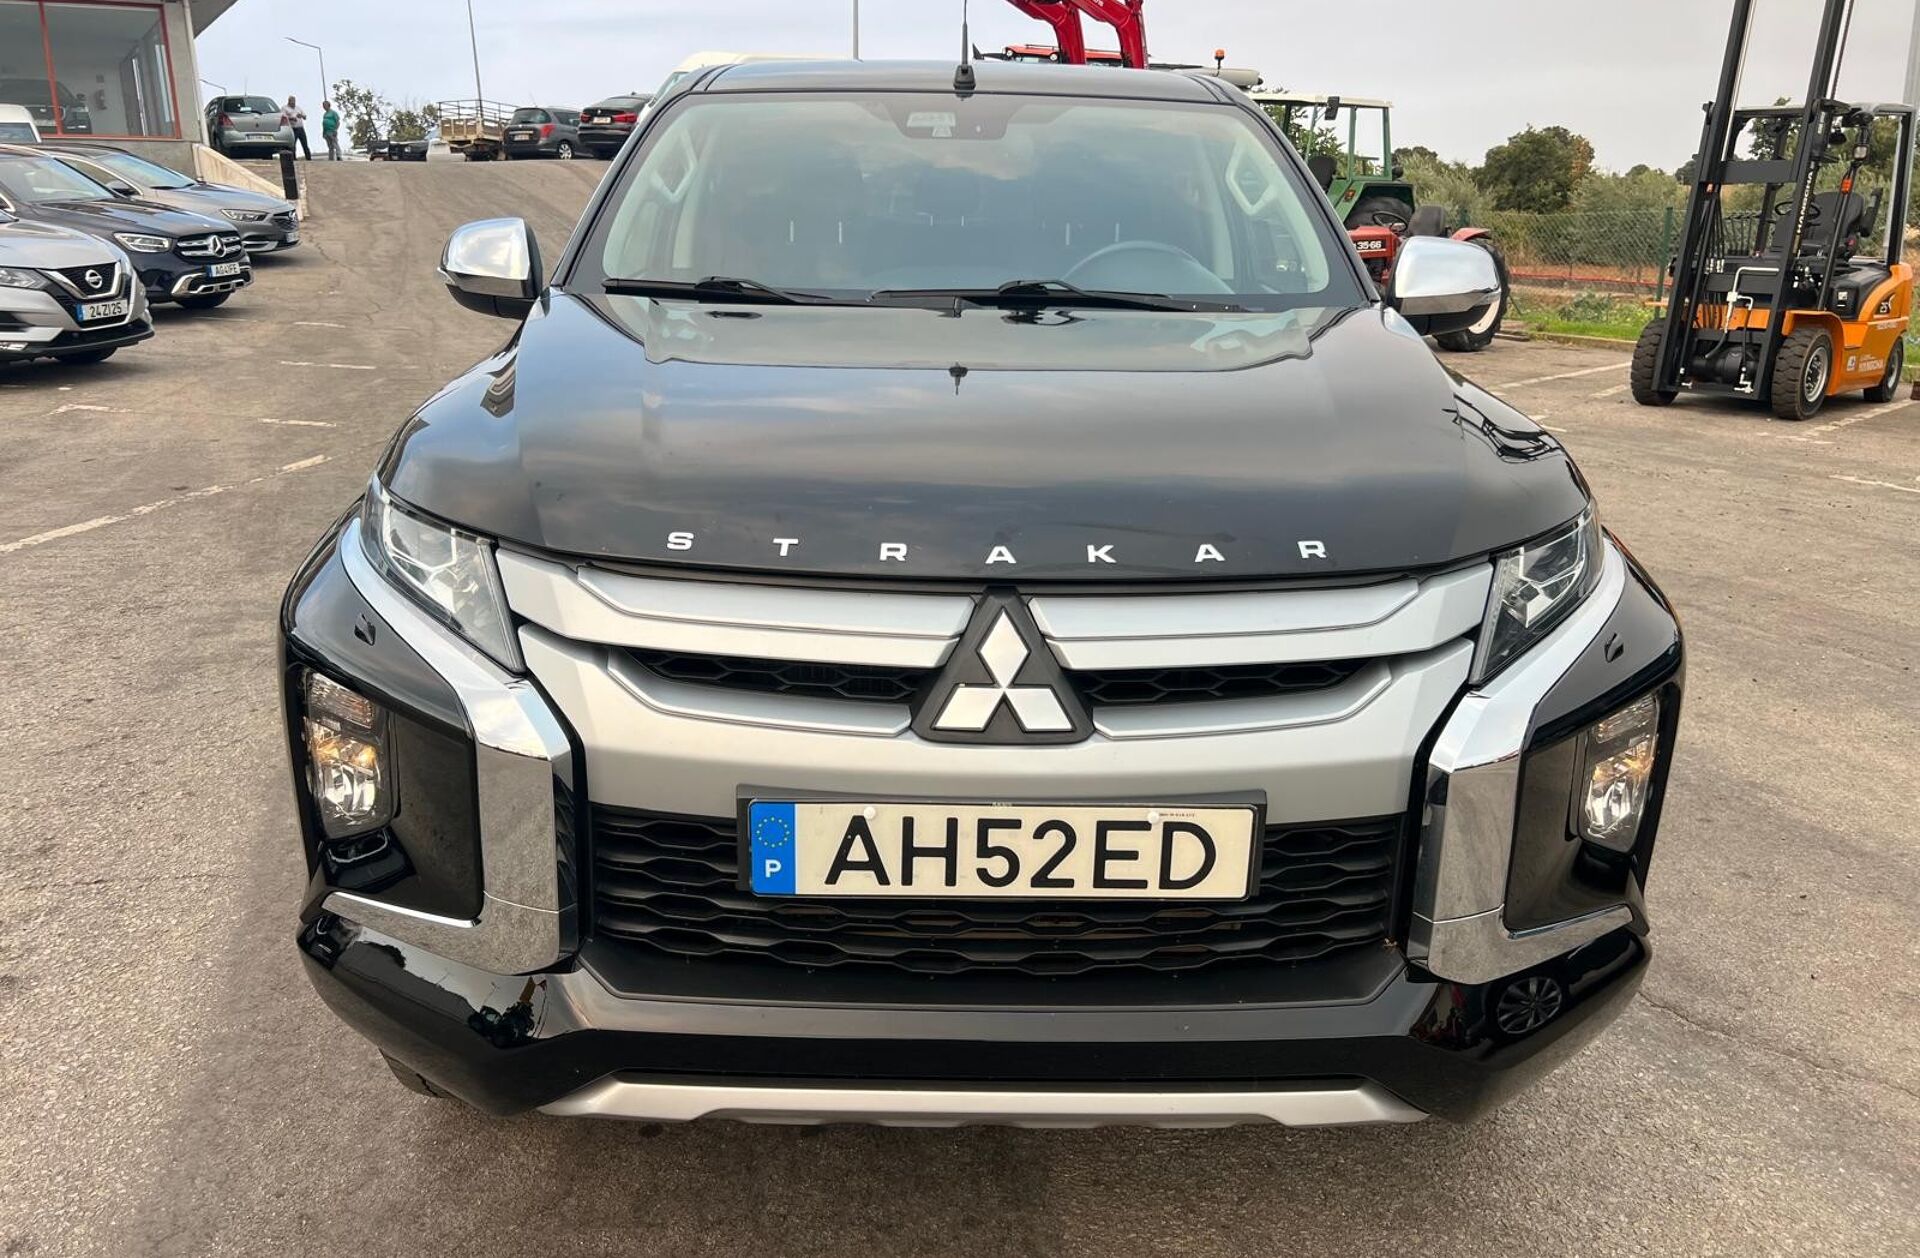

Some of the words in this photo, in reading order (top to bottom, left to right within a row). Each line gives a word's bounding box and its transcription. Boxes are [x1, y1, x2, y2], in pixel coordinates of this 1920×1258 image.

[667, 531, 1327, 564] STRAKAR
[765, 859, 781, 878] P
[825, 815, 1216, 889] AH52ED
